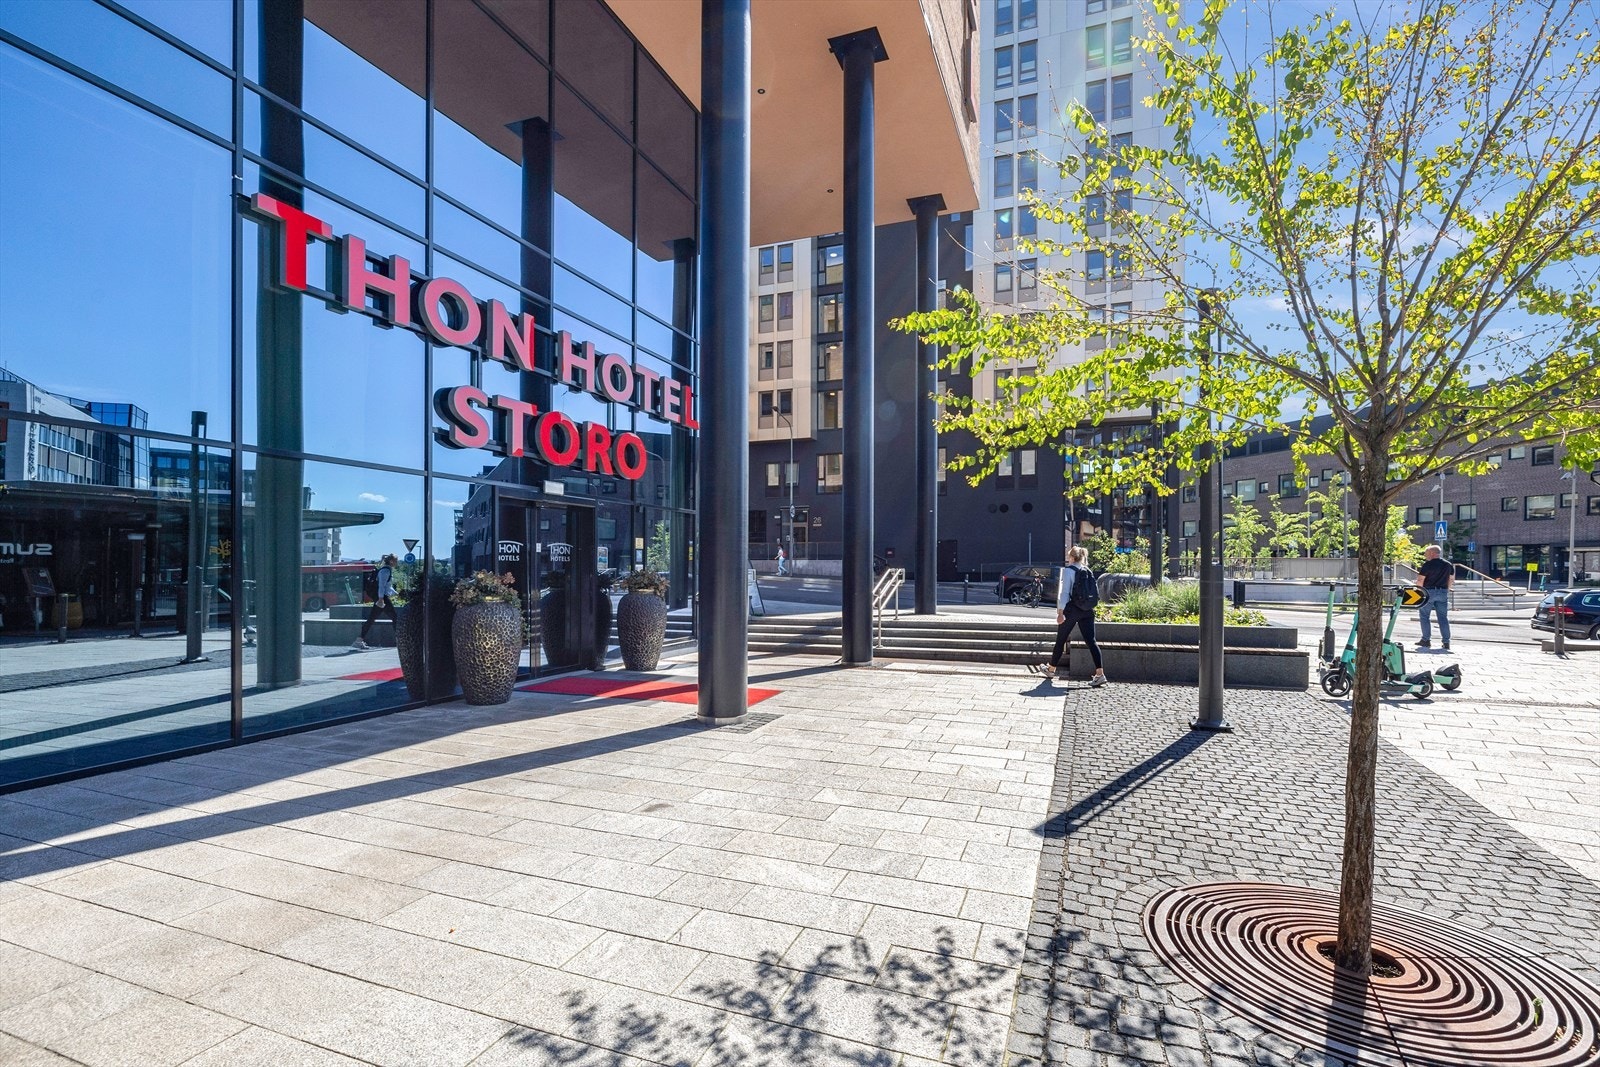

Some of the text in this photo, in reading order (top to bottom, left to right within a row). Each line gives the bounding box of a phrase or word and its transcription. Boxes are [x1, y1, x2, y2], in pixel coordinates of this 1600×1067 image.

[251, 192, 700, 430] THON HOTEL
[449, 385, 648, 481] STORO
